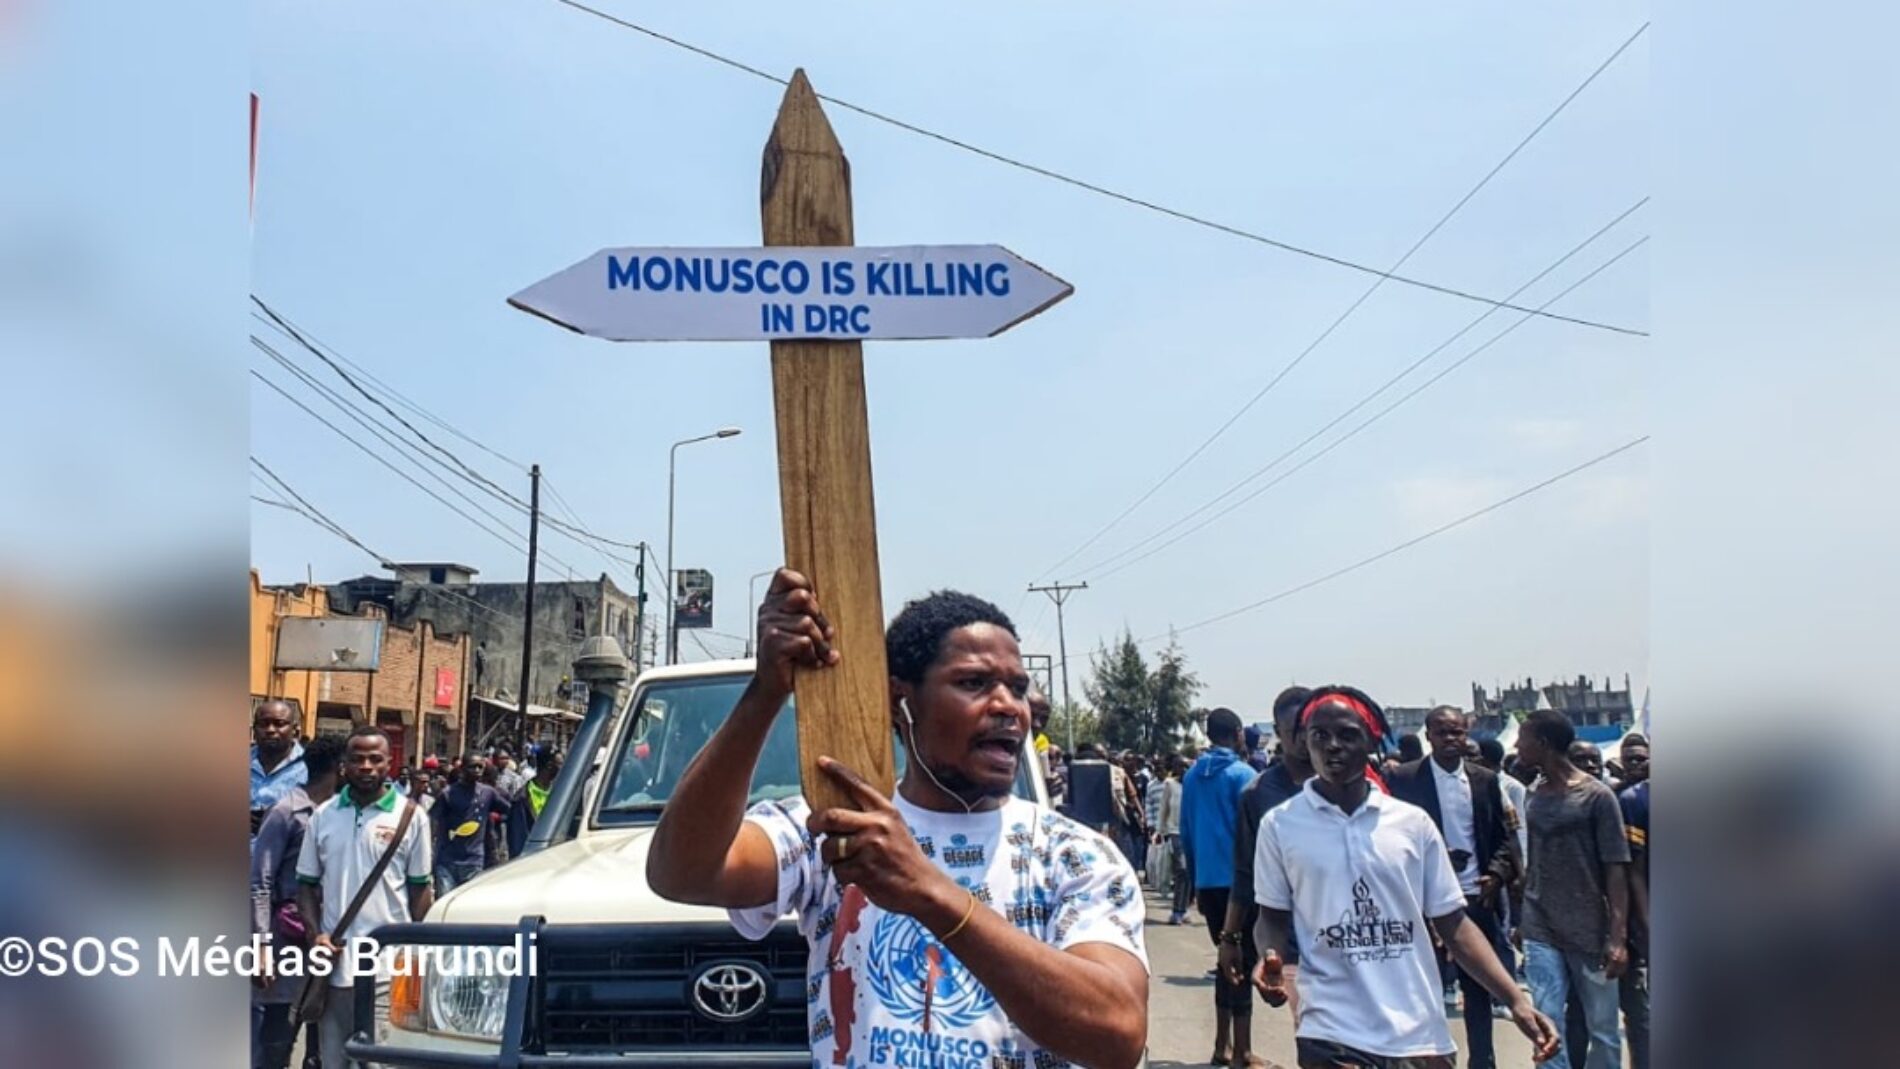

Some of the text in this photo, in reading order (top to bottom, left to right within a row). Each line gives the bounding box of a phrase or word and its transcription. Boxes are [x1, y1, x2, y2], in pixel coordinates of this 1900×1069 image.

[607, 255, 1010, 297] MONUSCO IS KILLING
[762, 304, 870, 334] IN DRC
[869, 1044, 983, 1069] IS KILLING
[870, 1026, 989, 1059] MONUSCO
